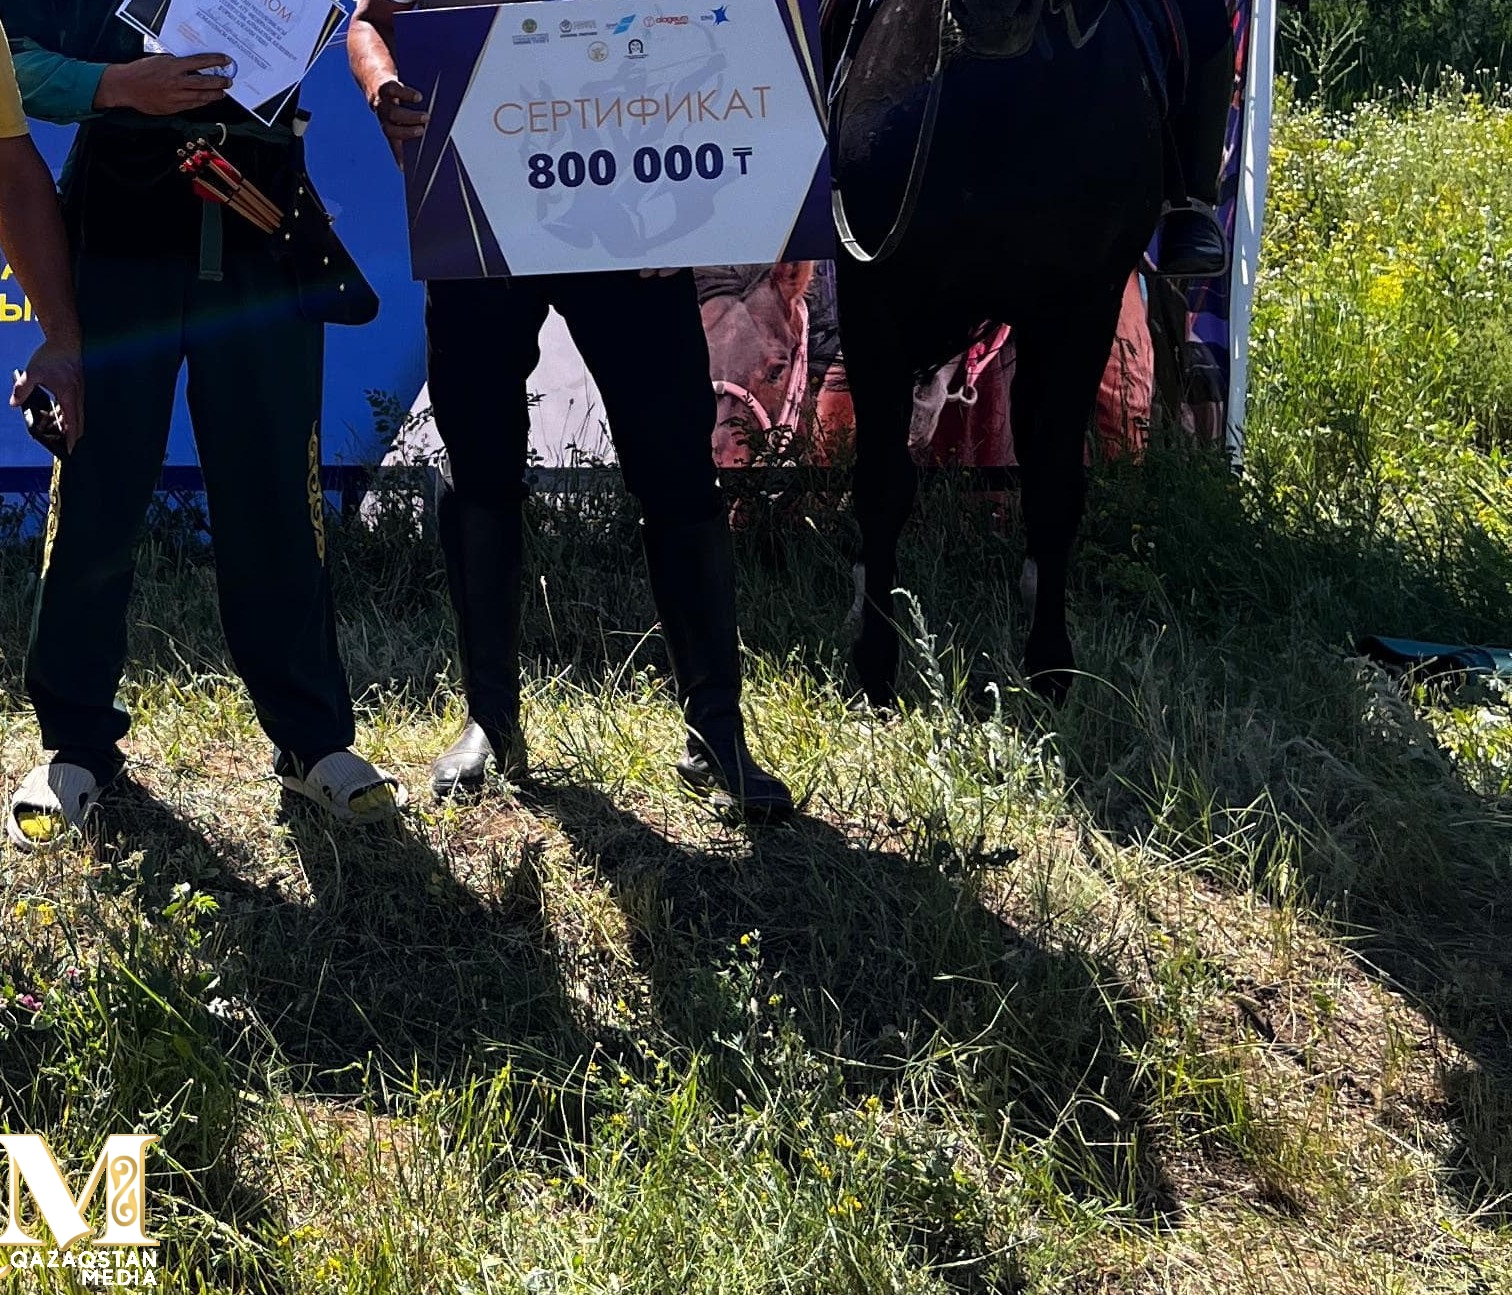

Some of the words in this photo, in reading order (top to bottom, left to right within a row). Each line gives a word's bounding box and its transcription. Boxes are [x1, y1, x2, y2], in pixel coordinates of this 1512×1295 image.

[492, 85, 772, 136] СЕРТИФИКАТ
[527, 149, 617, 190] 800
[632, 142, 724, 183] 000
